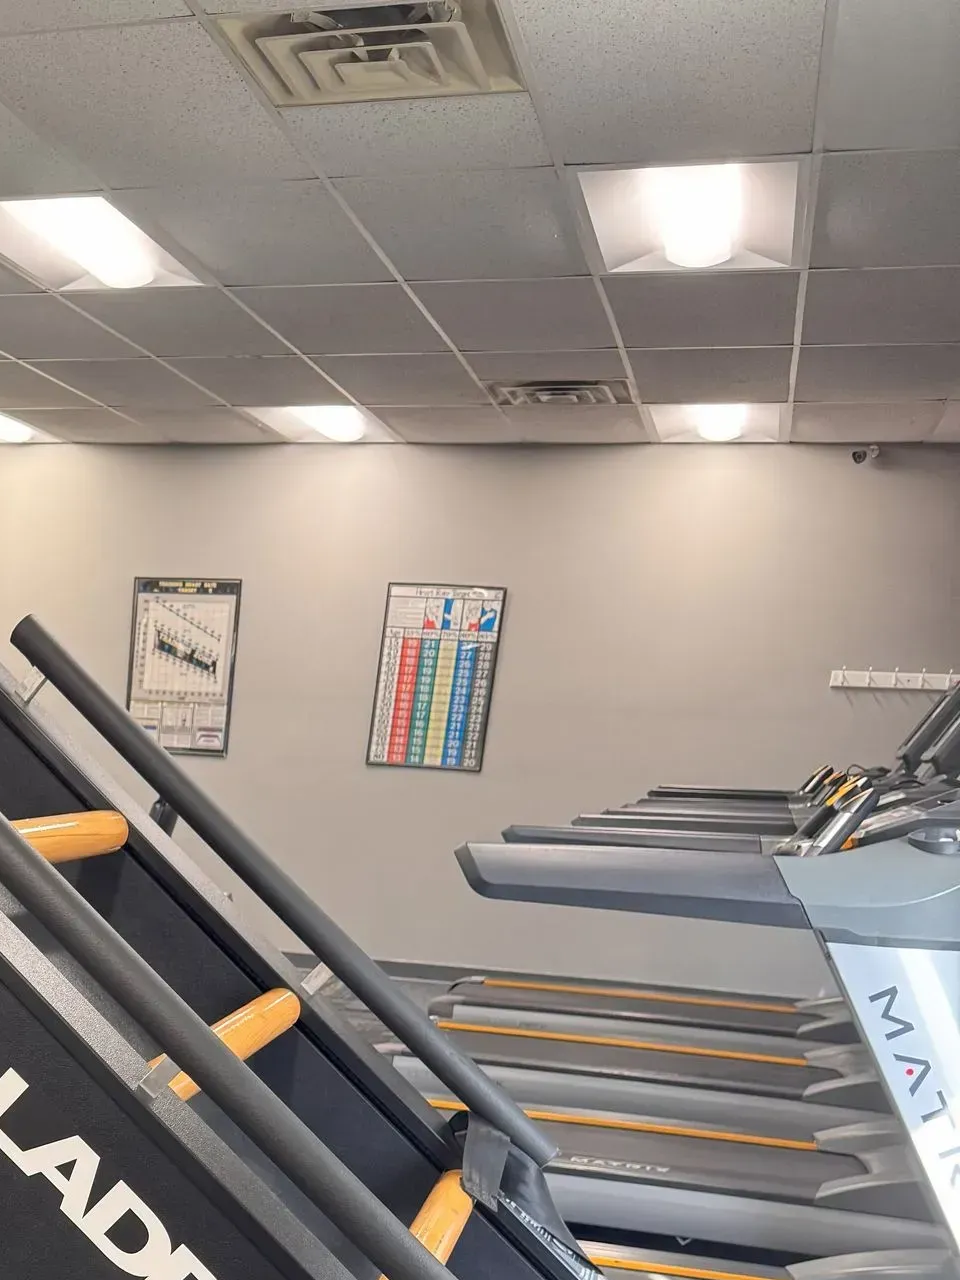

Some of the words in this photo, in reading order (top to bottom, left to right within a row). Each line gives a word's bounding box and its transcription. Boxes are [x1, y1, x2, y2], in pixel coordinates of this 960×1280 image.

[423, 640, 435, 648] 21
[479, 642, 491, 650] 29
[422, 649, 434, 657] 20
[478, 651, 490, 659] 28
[423, 658, 433, 666] 19
[458, 659, 470, 667] 26
[476, 660, 489, 668] 28
[475, 669, 488, 677] 27
[417, 702, 426, 710] 17
[466, 731, 479, 739] 22
[447, 739, 458, 747] 20
[465, 740, 477, 748] 21
[462, 758, 475, 766] 20
